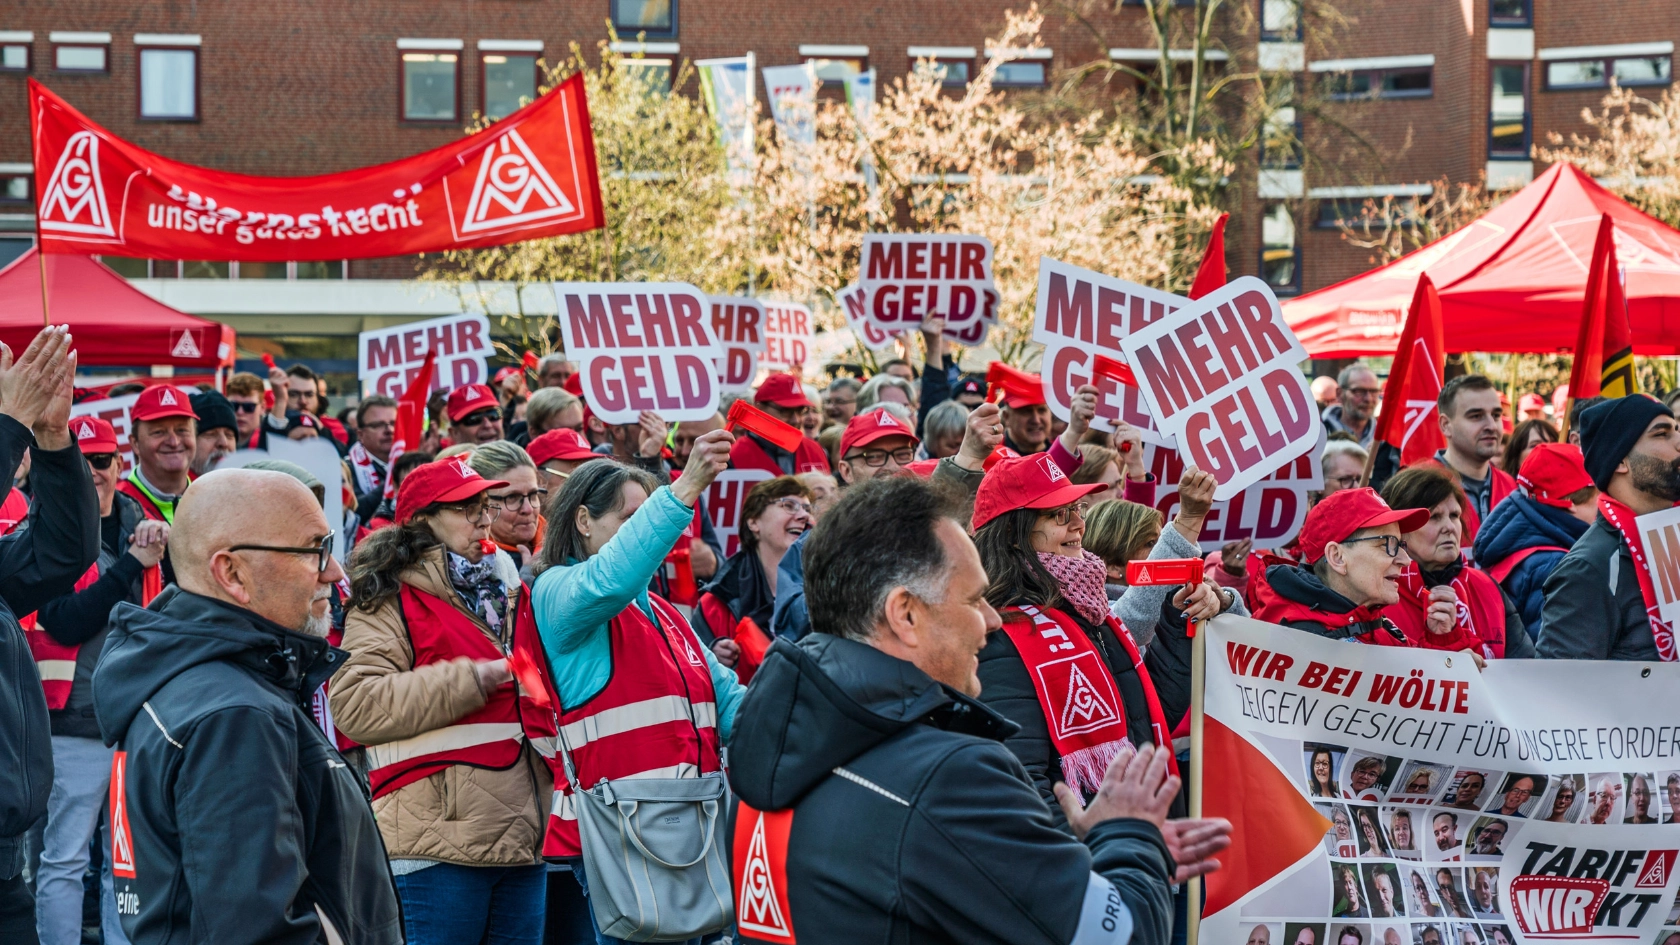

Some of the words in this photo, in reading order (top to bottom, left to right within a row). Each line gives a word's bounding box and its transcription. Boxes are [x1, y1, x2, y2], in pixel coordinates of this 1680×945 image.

[867, 242, 986, 280] MEHR
[565, 293, 710, 348] MEHR
[764, 308, 809, 336] EHR
[873, 285, 976, 322] GELD
[1045, 271, 1180, 347] MEH
[367, 320, 484, 371] MEHR
[1135, 290, 1292, 420] MEHR
[589, 355, 711, 412] GELD
[1186, 368, 1311, 486] GELD
[1067, 675, 1107, 726] IGM
[1226, 641, 1294, 682] WIR
[1297, 661, 1363, 698] BEI
[1367, 669, 1469, 714] WÖLTE
[1236, 684, 1319, 726] ZEIGEN
[1323, 704, 1456, 751] GESICHT
[1456, 720, 1511, 760] FÜR
[1515, 728, 1594, 762] UNSERE
[743, 832, 781, 927] IGM
[1520, 841, 1646, 887] TARIF
